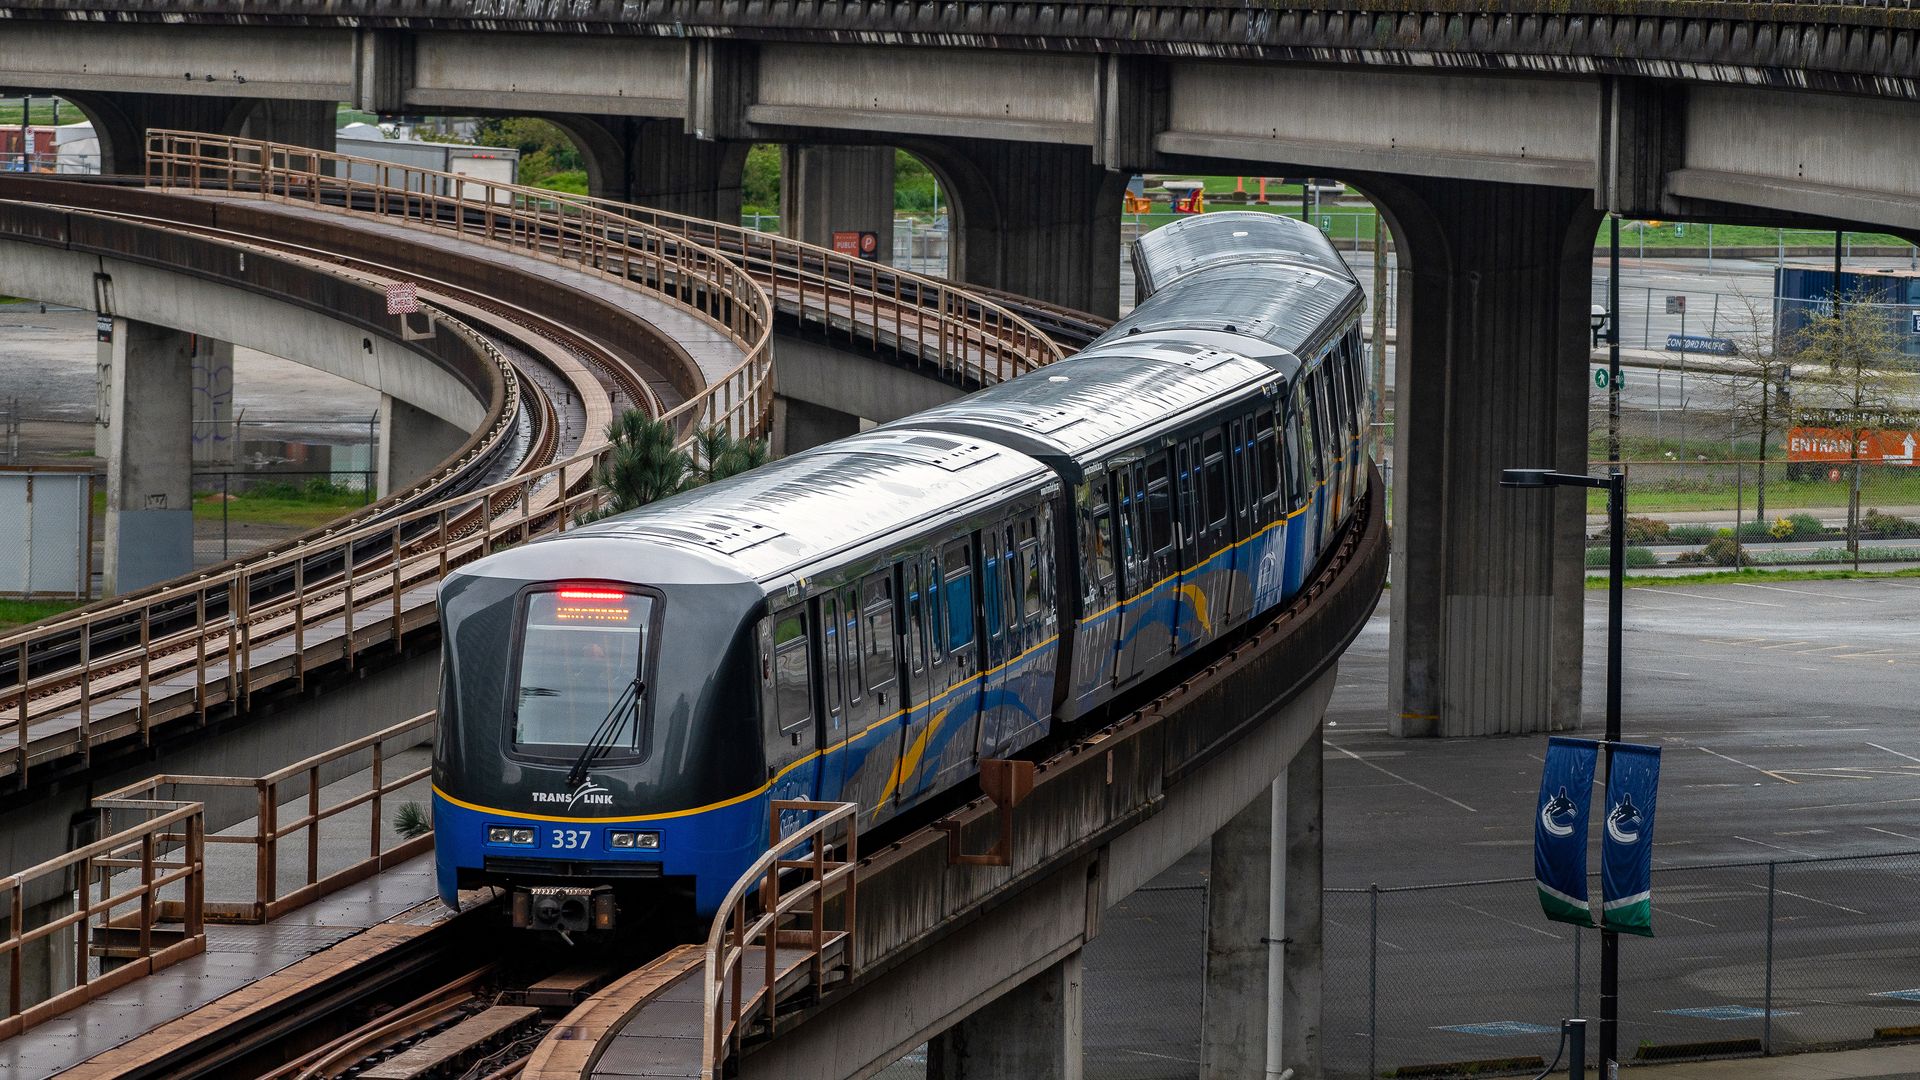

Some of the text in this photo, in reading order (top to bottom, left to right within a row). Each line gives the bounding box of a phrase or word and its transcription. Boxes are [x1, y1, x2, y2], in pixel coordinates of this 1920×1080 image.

[837, 241, 857, 249] PUBLIC
[392, 291, 411, 299] SWITCH
[394, 299, 411, 307] AHEAD
[1791, 437, 1868, 454] ENTRANE
[551, 829, 591, 849] 337
